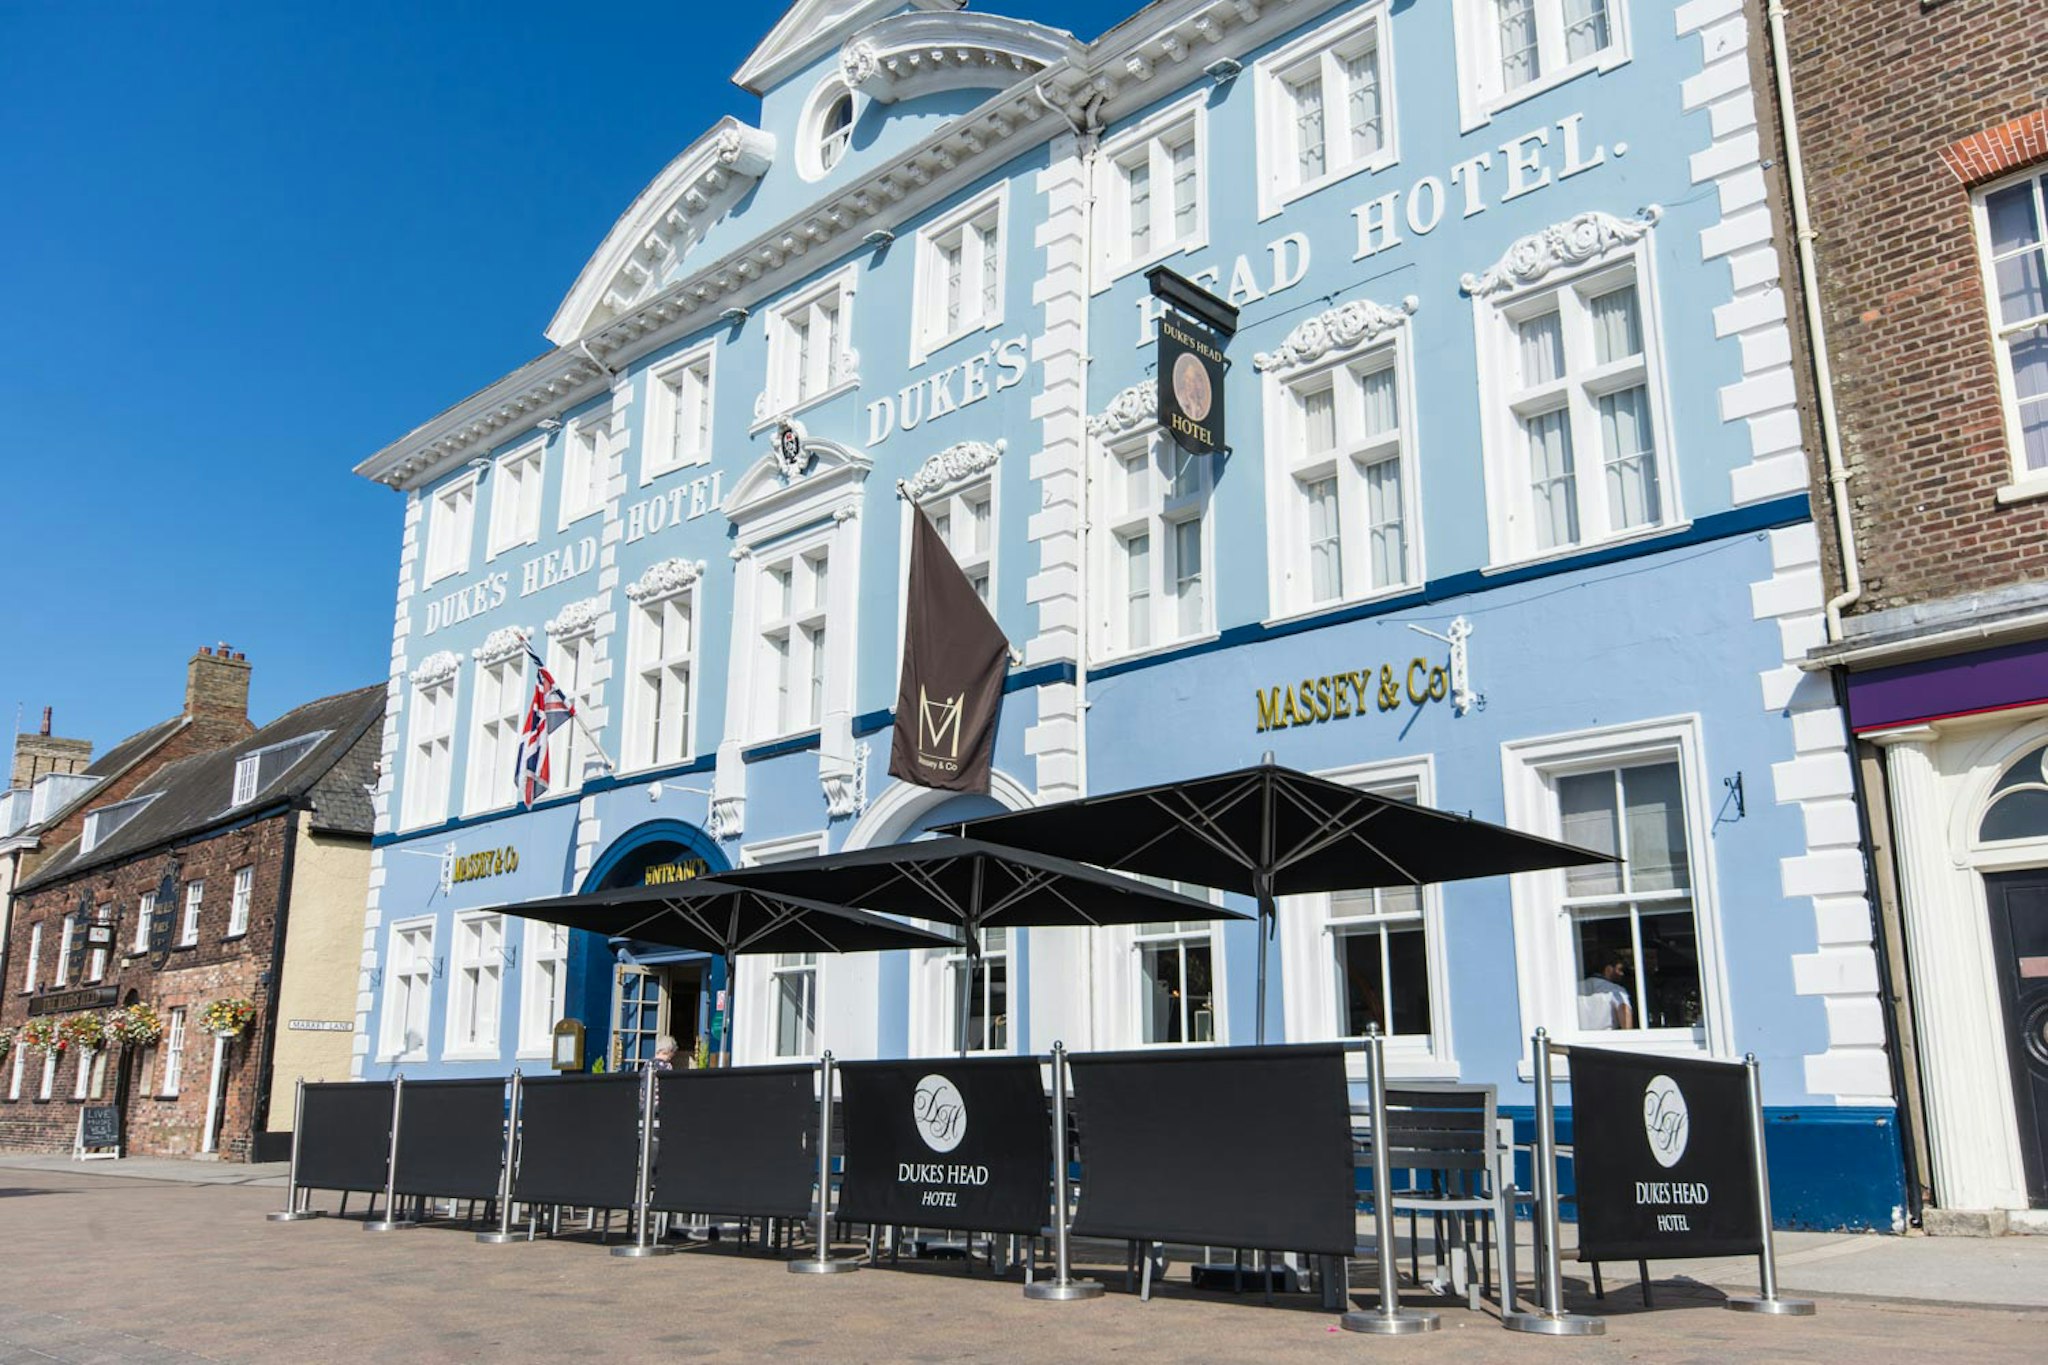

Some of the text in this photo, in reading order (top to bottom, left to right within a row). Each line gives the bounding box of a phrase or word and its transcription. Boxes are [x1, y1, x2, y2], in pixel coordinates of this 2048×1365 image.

[1164, 322, 1222, 363] DUKE'S HEAD
[865, 334, 1027, 448] DUKE'S
[1171, 413, 1214, 446] HOTEL
[423, 571, 509, 636] DUKE'S
[520, 536, 597, 597] HEAD
[1256, 656, 1448, 733] MASSEY & Co
[945, 762, 958, 771] Co
[494, 848, 503, 876] &
[504, 844, 519, 873] Co
[292, 1021, 351, 1030] MARKET LANE
[898, 1163, 989, 1185] DUKES HEAD
[921, 1191, 957, 1207] HOTEL
[1635, 1182, 1709, 1205] DUKES HEAD
[1657, 1214, 1690, 1232] HOTEL
